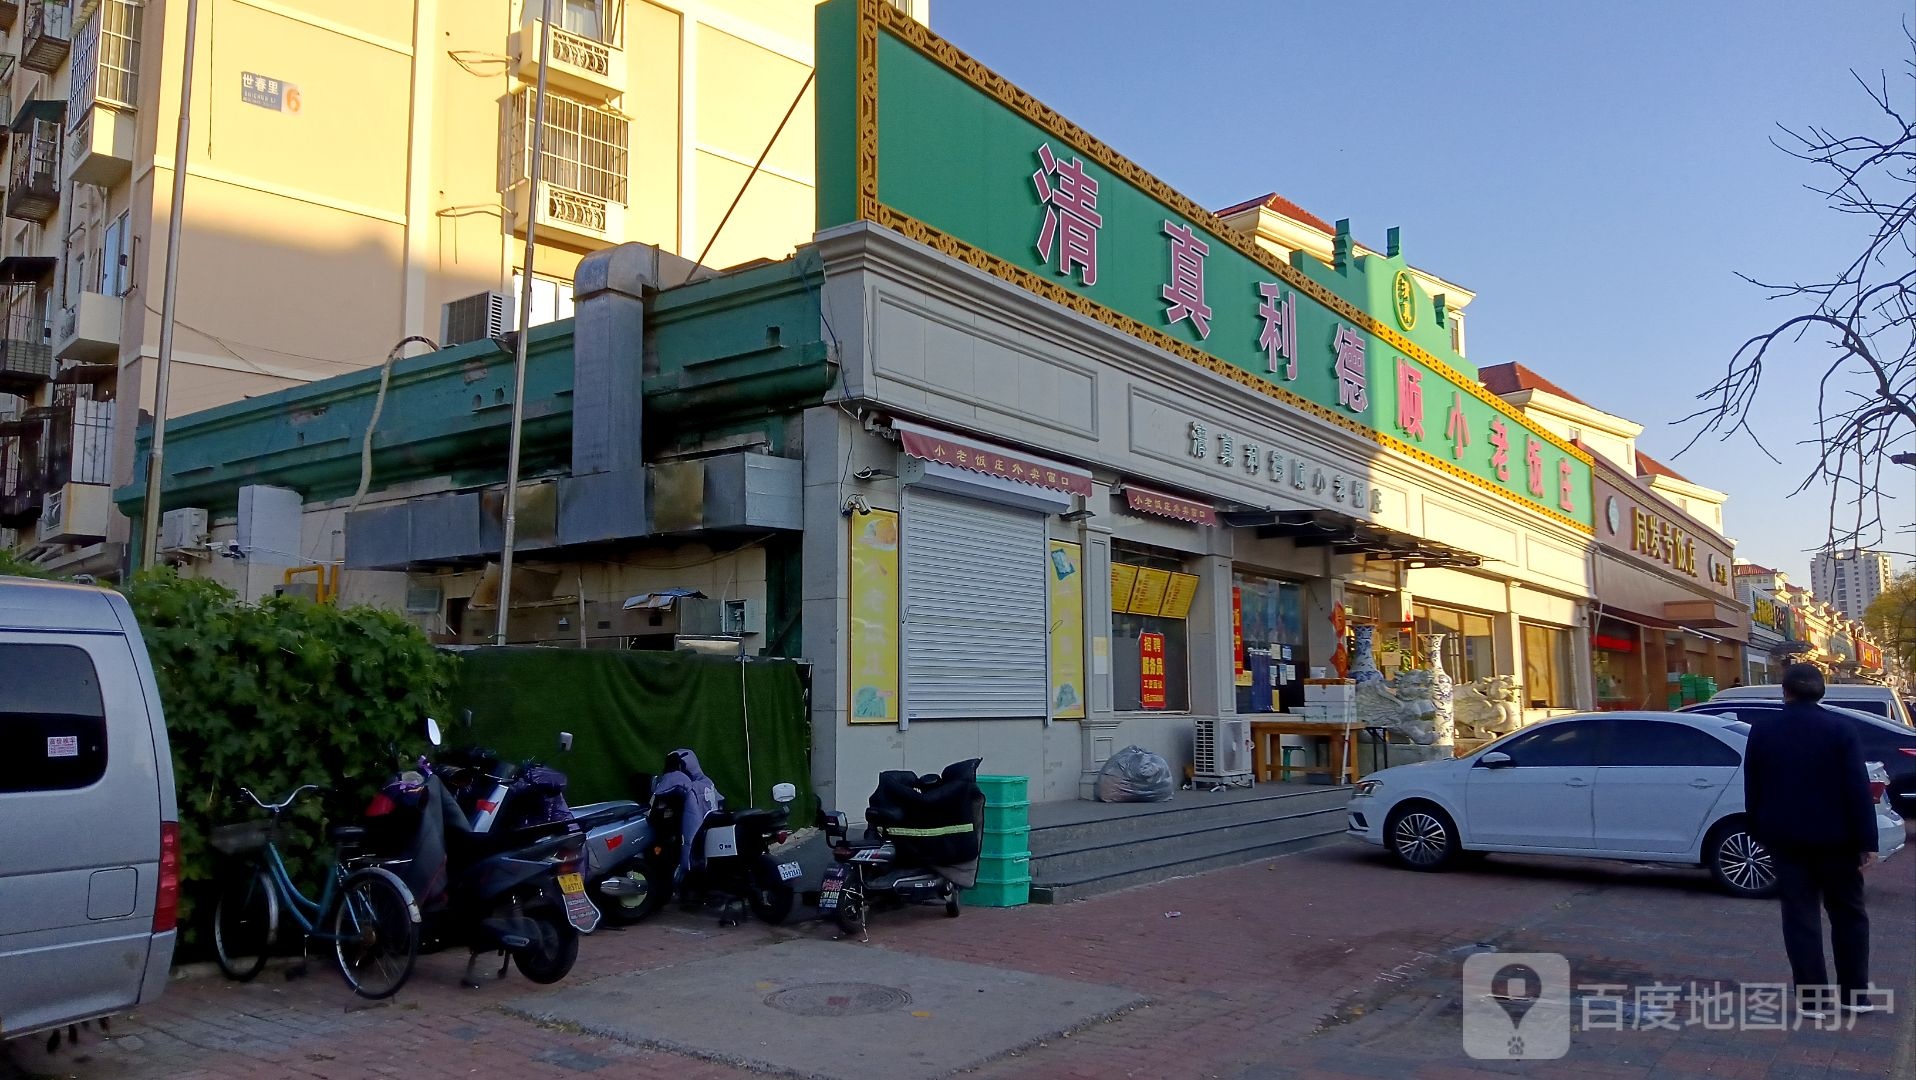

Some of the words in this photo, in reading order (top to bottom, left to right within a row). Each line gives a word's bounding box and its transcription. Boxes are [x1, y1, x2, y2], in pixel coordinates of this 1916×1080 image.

[242, 73, 279, 95] 世春里
[286, 87, 301, 112] 6
[1032, 142, 1575, 513] 清真利德顺小老饭庄
[934, 444, 1070, 487] 小老饭庄外卖窗口
[1190, 420, 1382, 514] 清真利德顺小老饭庄
[1134, 495, 1206, 518] 小老饭庄外卖窗口
[1630, 506, 1698, 578] 同发号饭庄
[1144, 636, 1161, 653] 招聘
[1142, 656, 1164, 676] 服务员
